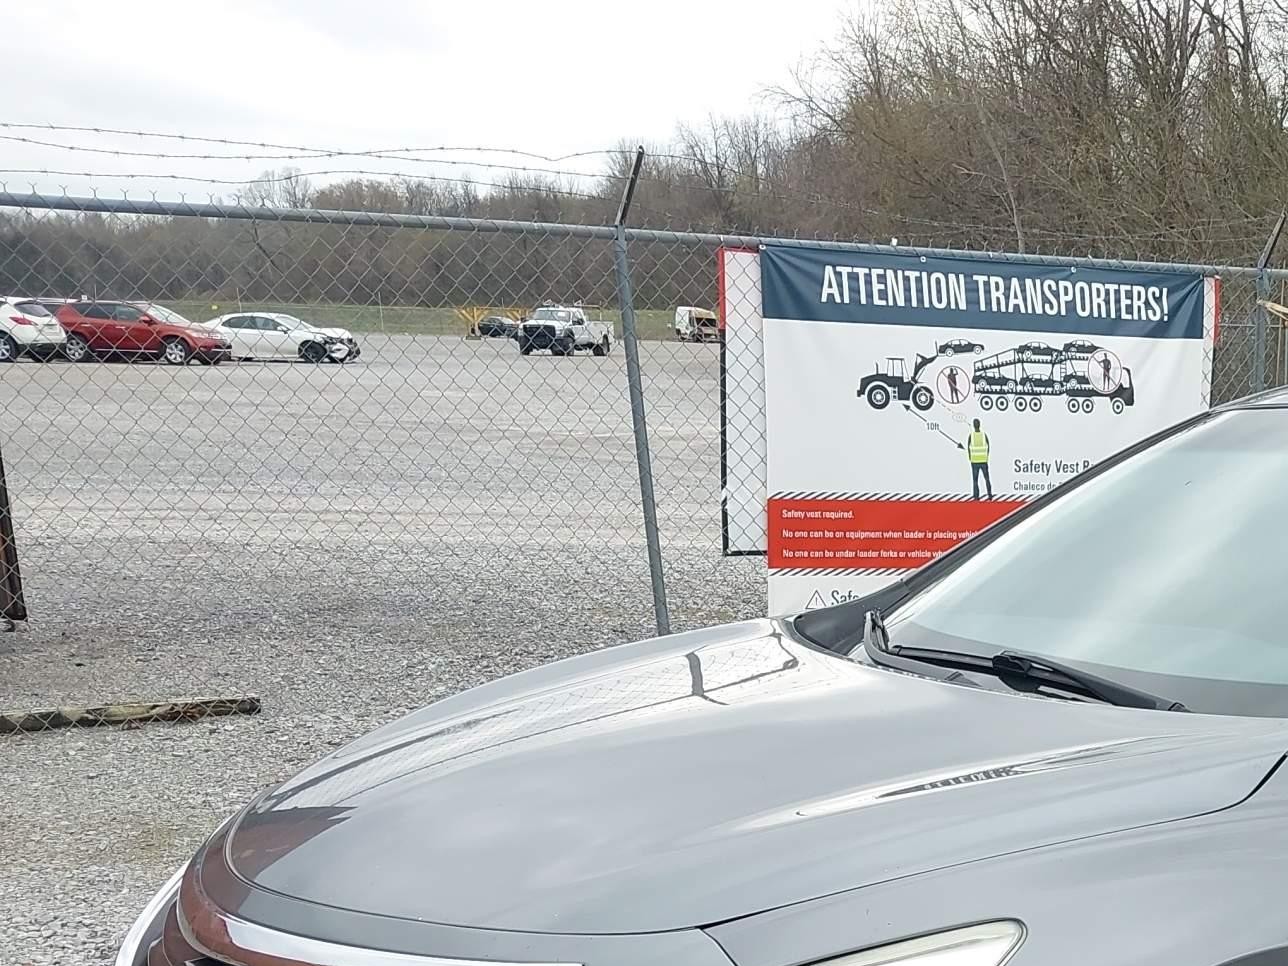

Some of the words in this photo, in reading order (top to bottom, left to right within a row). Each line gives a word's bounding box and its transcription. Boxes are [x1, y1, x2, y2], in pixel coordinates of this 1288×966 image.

[821, 265, 967, 311] ATTENTION
[972, 273, 1169, 322] TRANSPORTERS!
[926, 422, 940, 431] 10ft
[1014, 459, 1051, 476] Safety
[1054, 459, 1080, 474] Vest
[1013, 481, 1045, 491] Chaleco
[782, 509, 805, 520] Safety
[806, 510, 821, 518] vest
[822, 510, 855, 520] required.
[782, 529, 793, 538] No
[824, 529, 834, 538] be
[845, 530, 882, 540] equipment
[883, 530, 903, 539] when
[903, 530, 925, 539] loader
[926, 530, 932, 539] is
[933, 530, 957, 541] placing
[782, 549, 794, 558] No
[824, 549, 834, 558] be
[835, 549, 855, 558] under
[857, 549, 879, 558] loader
[880, 549, 897, 558] forks
[907, 549, 932, 558] vehicle
